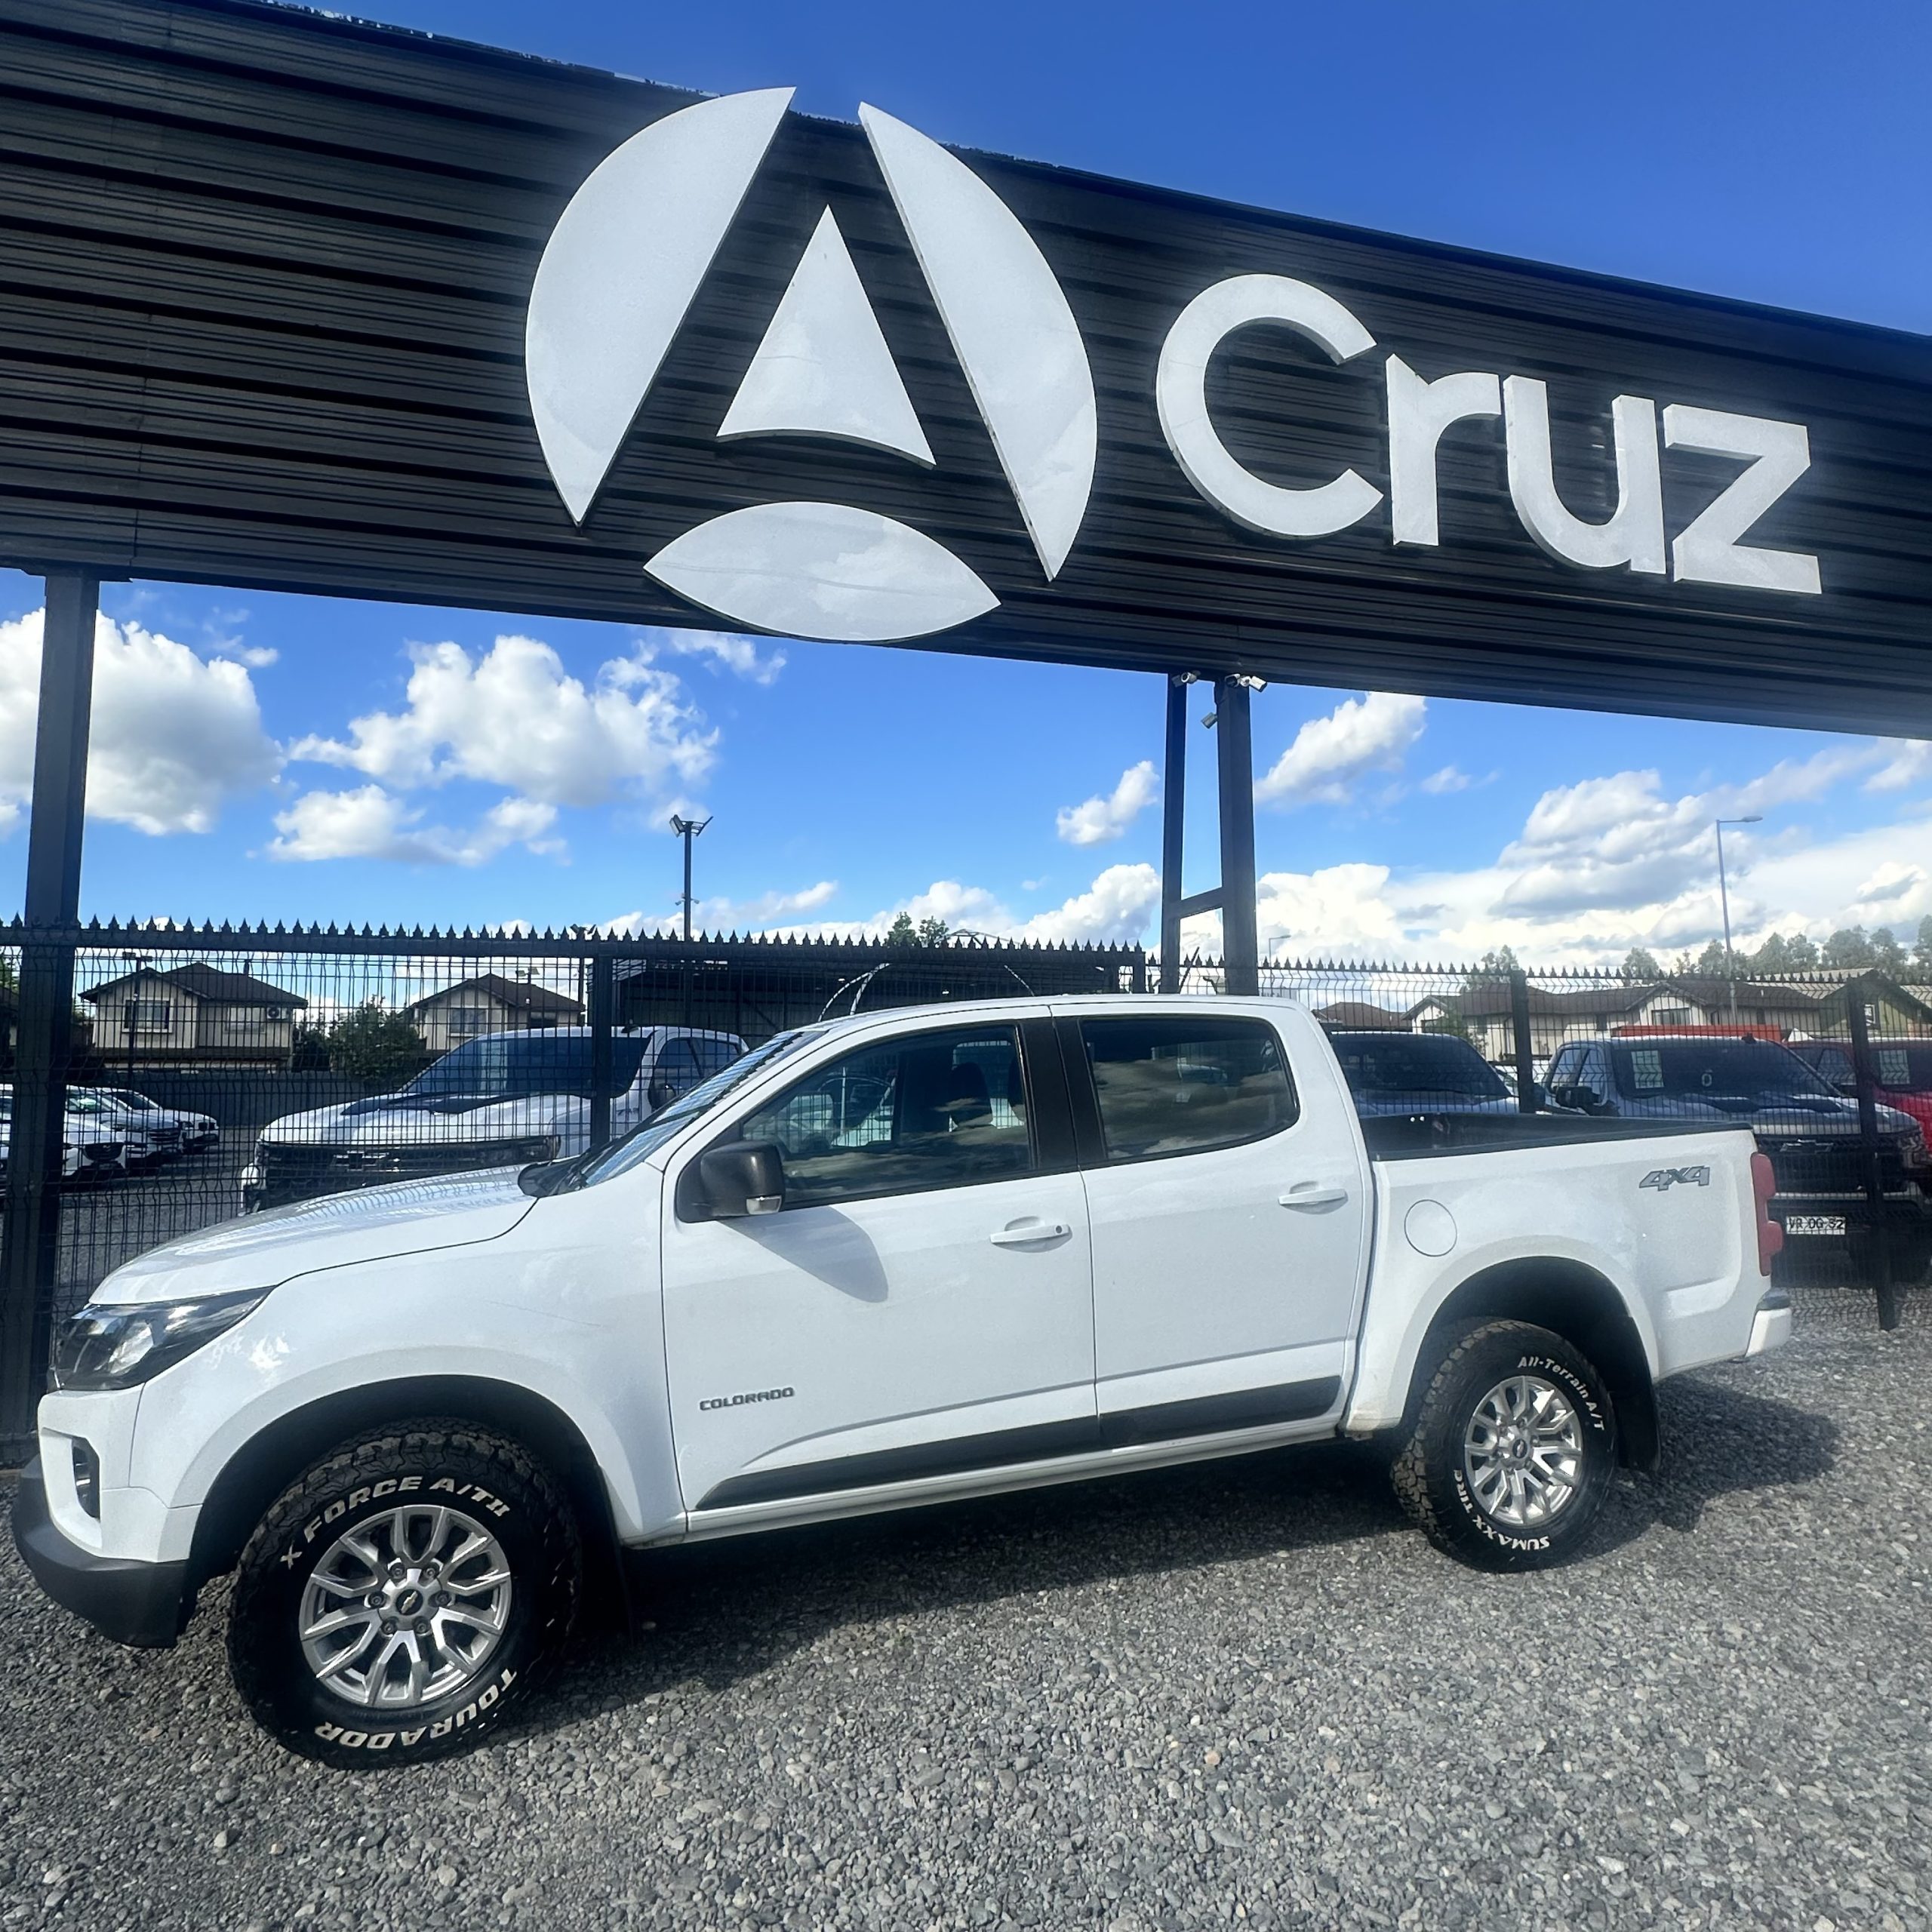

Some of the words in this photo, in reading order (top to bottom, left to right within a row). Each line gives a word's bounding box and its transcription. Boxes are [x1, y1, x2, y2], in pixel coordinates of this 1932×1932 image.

[1155, 272, 1822, 594] Cruz
[699, 1386, 795, 1411] COLORADO
[1517, 1356, 1589, 1399] All-Terrain
[303, 1476, 423, 1543] FORCE
[1472, 1515, 1550, 1551] SUMAXX
[315, 1669, 517, 1749] TOURADOR
